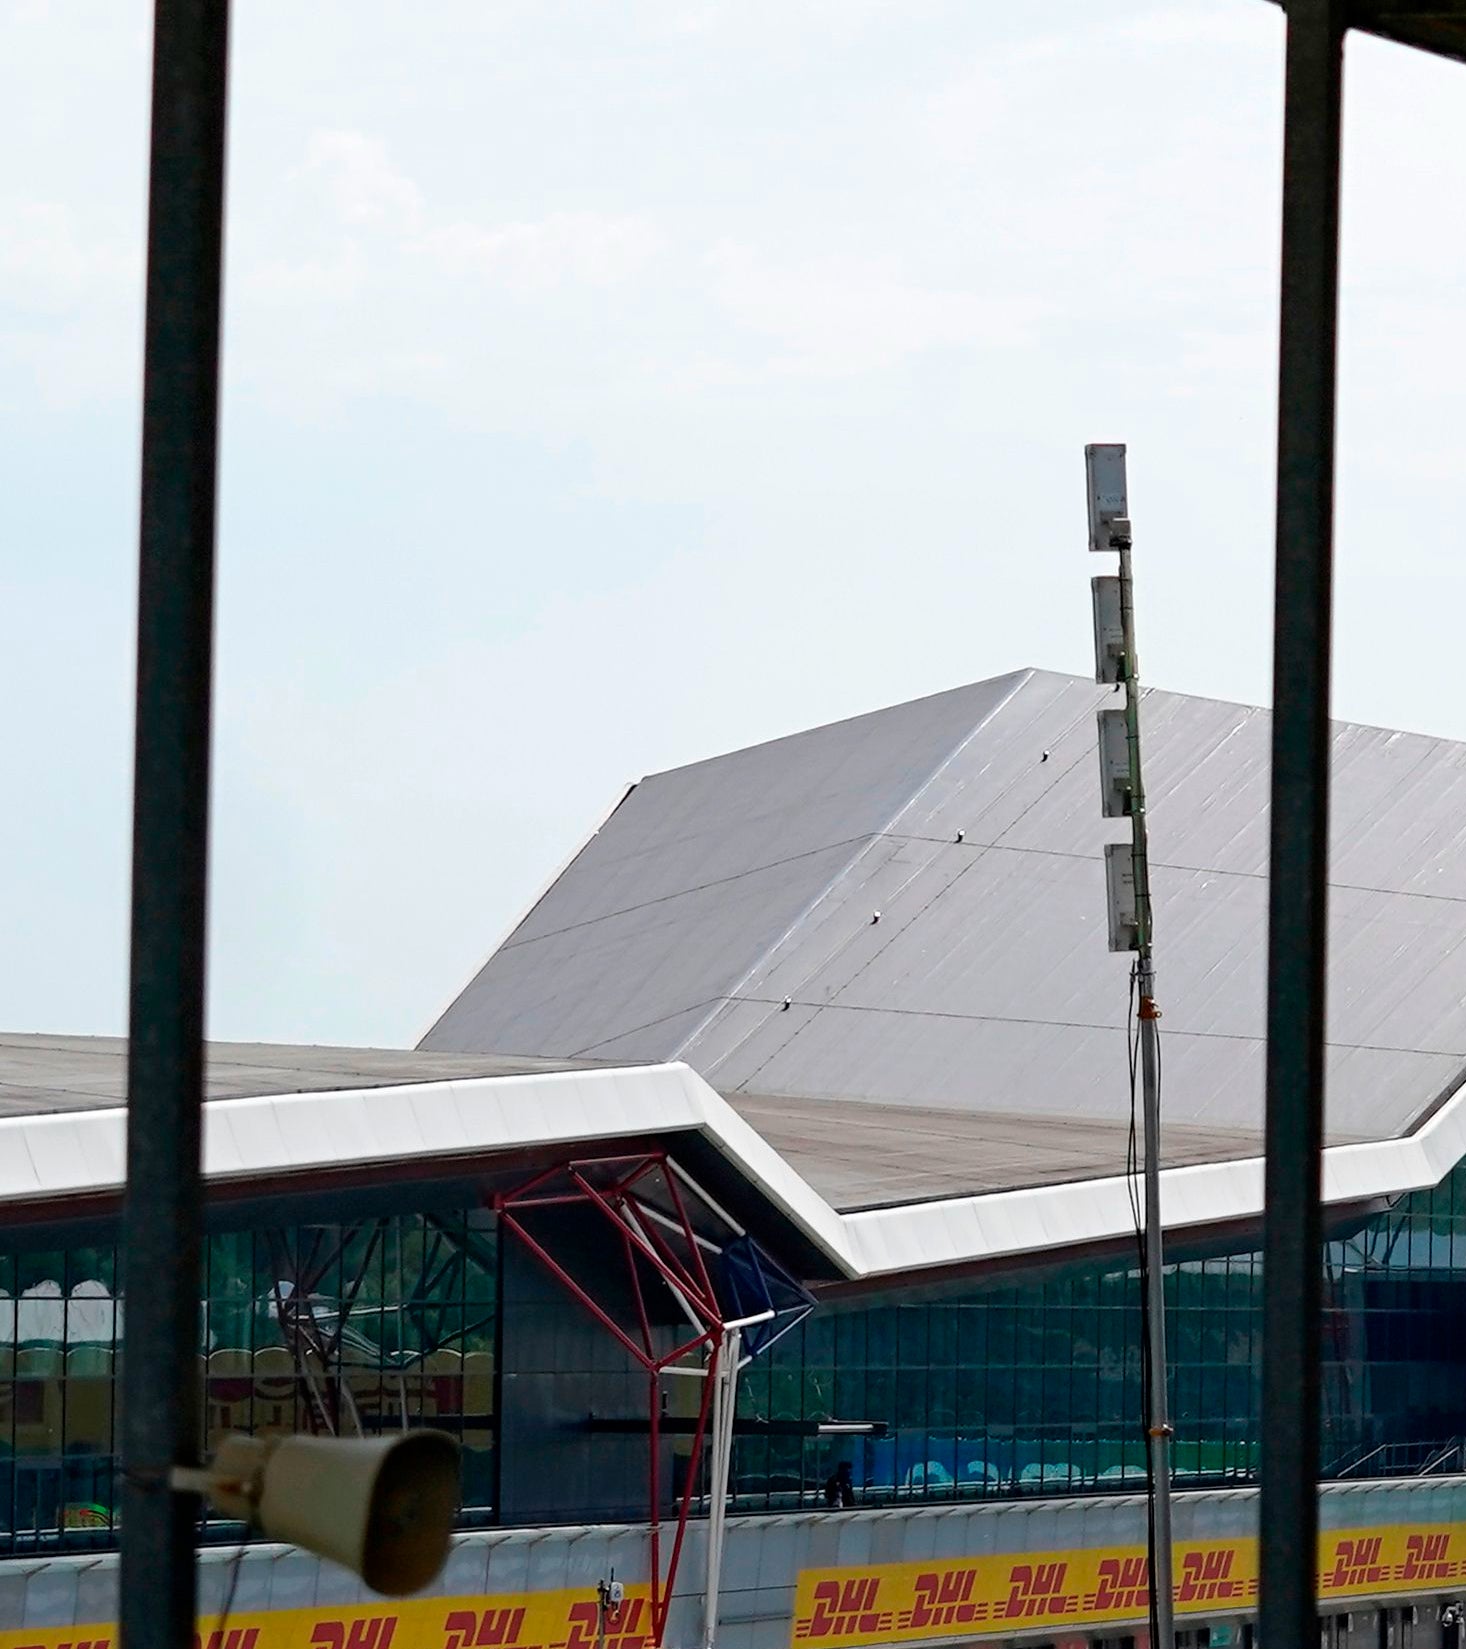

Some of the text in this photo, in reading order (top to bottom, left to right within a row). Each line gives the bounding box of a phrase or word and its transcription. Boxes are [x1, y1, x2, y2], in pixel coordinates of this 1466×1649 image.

[1179, 1550, 1235, 1601] DHL
[1330, 1537, 1382, 1587] DHL
[1403, 1534, 1451, 1580] DHL
[809, 1578, 880, 1637] DHL
[911, 1569, 977, 1628] DHL
[1005, 1563, 1068, 1618] DHL
